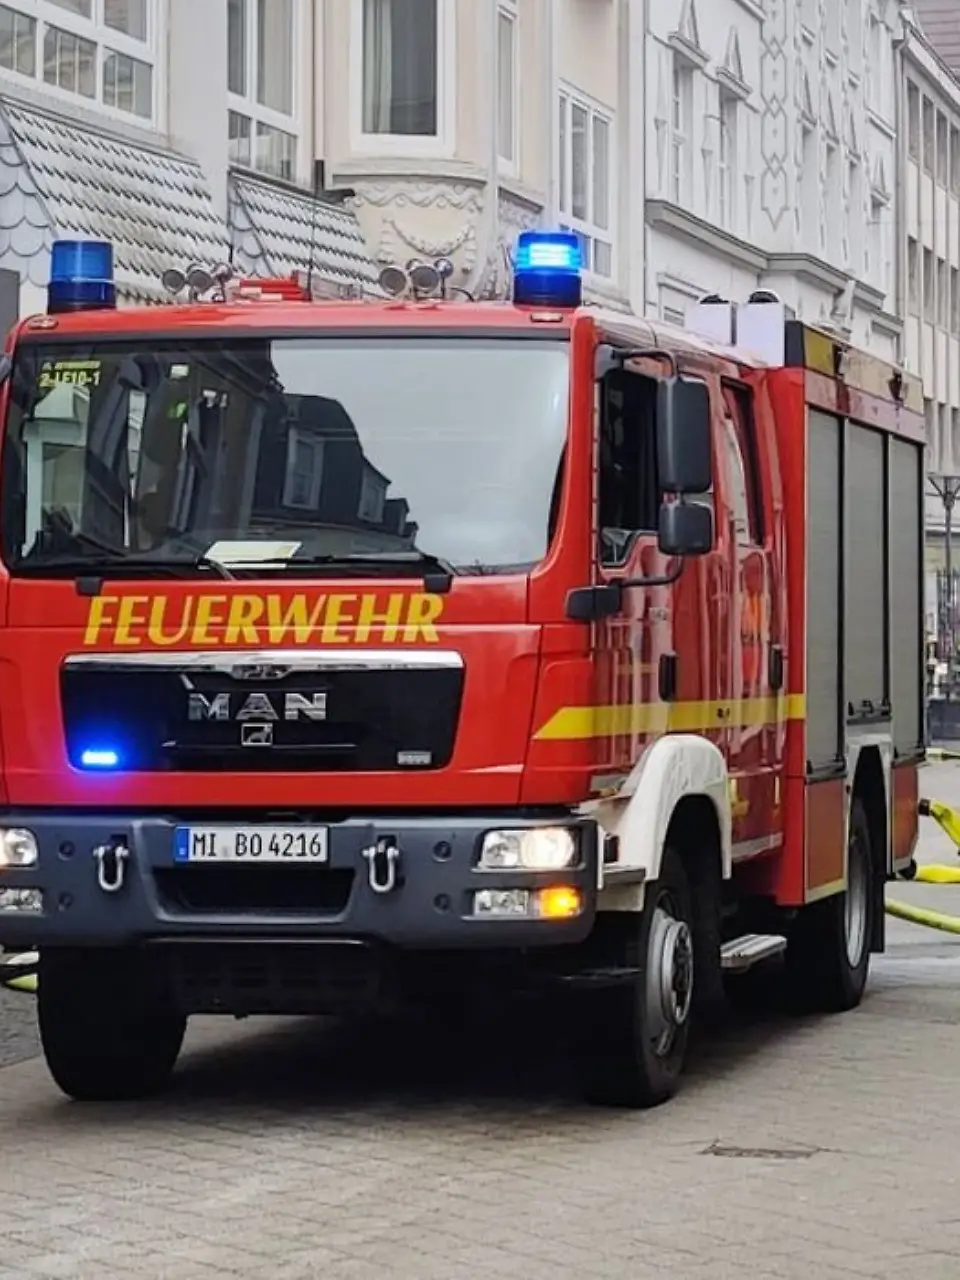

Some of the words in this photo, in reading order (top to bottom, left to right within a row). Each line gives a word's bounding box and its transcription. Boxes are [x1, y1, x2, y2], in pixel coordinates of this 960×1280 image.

[83, 593, 444, 646] FEUERWEHR
[188, 693, 327, 720] MAN
[193, 833, 217, 857] MI
[235, 833, 262, 857] BO
[268, 833, 321, 857] 4216
